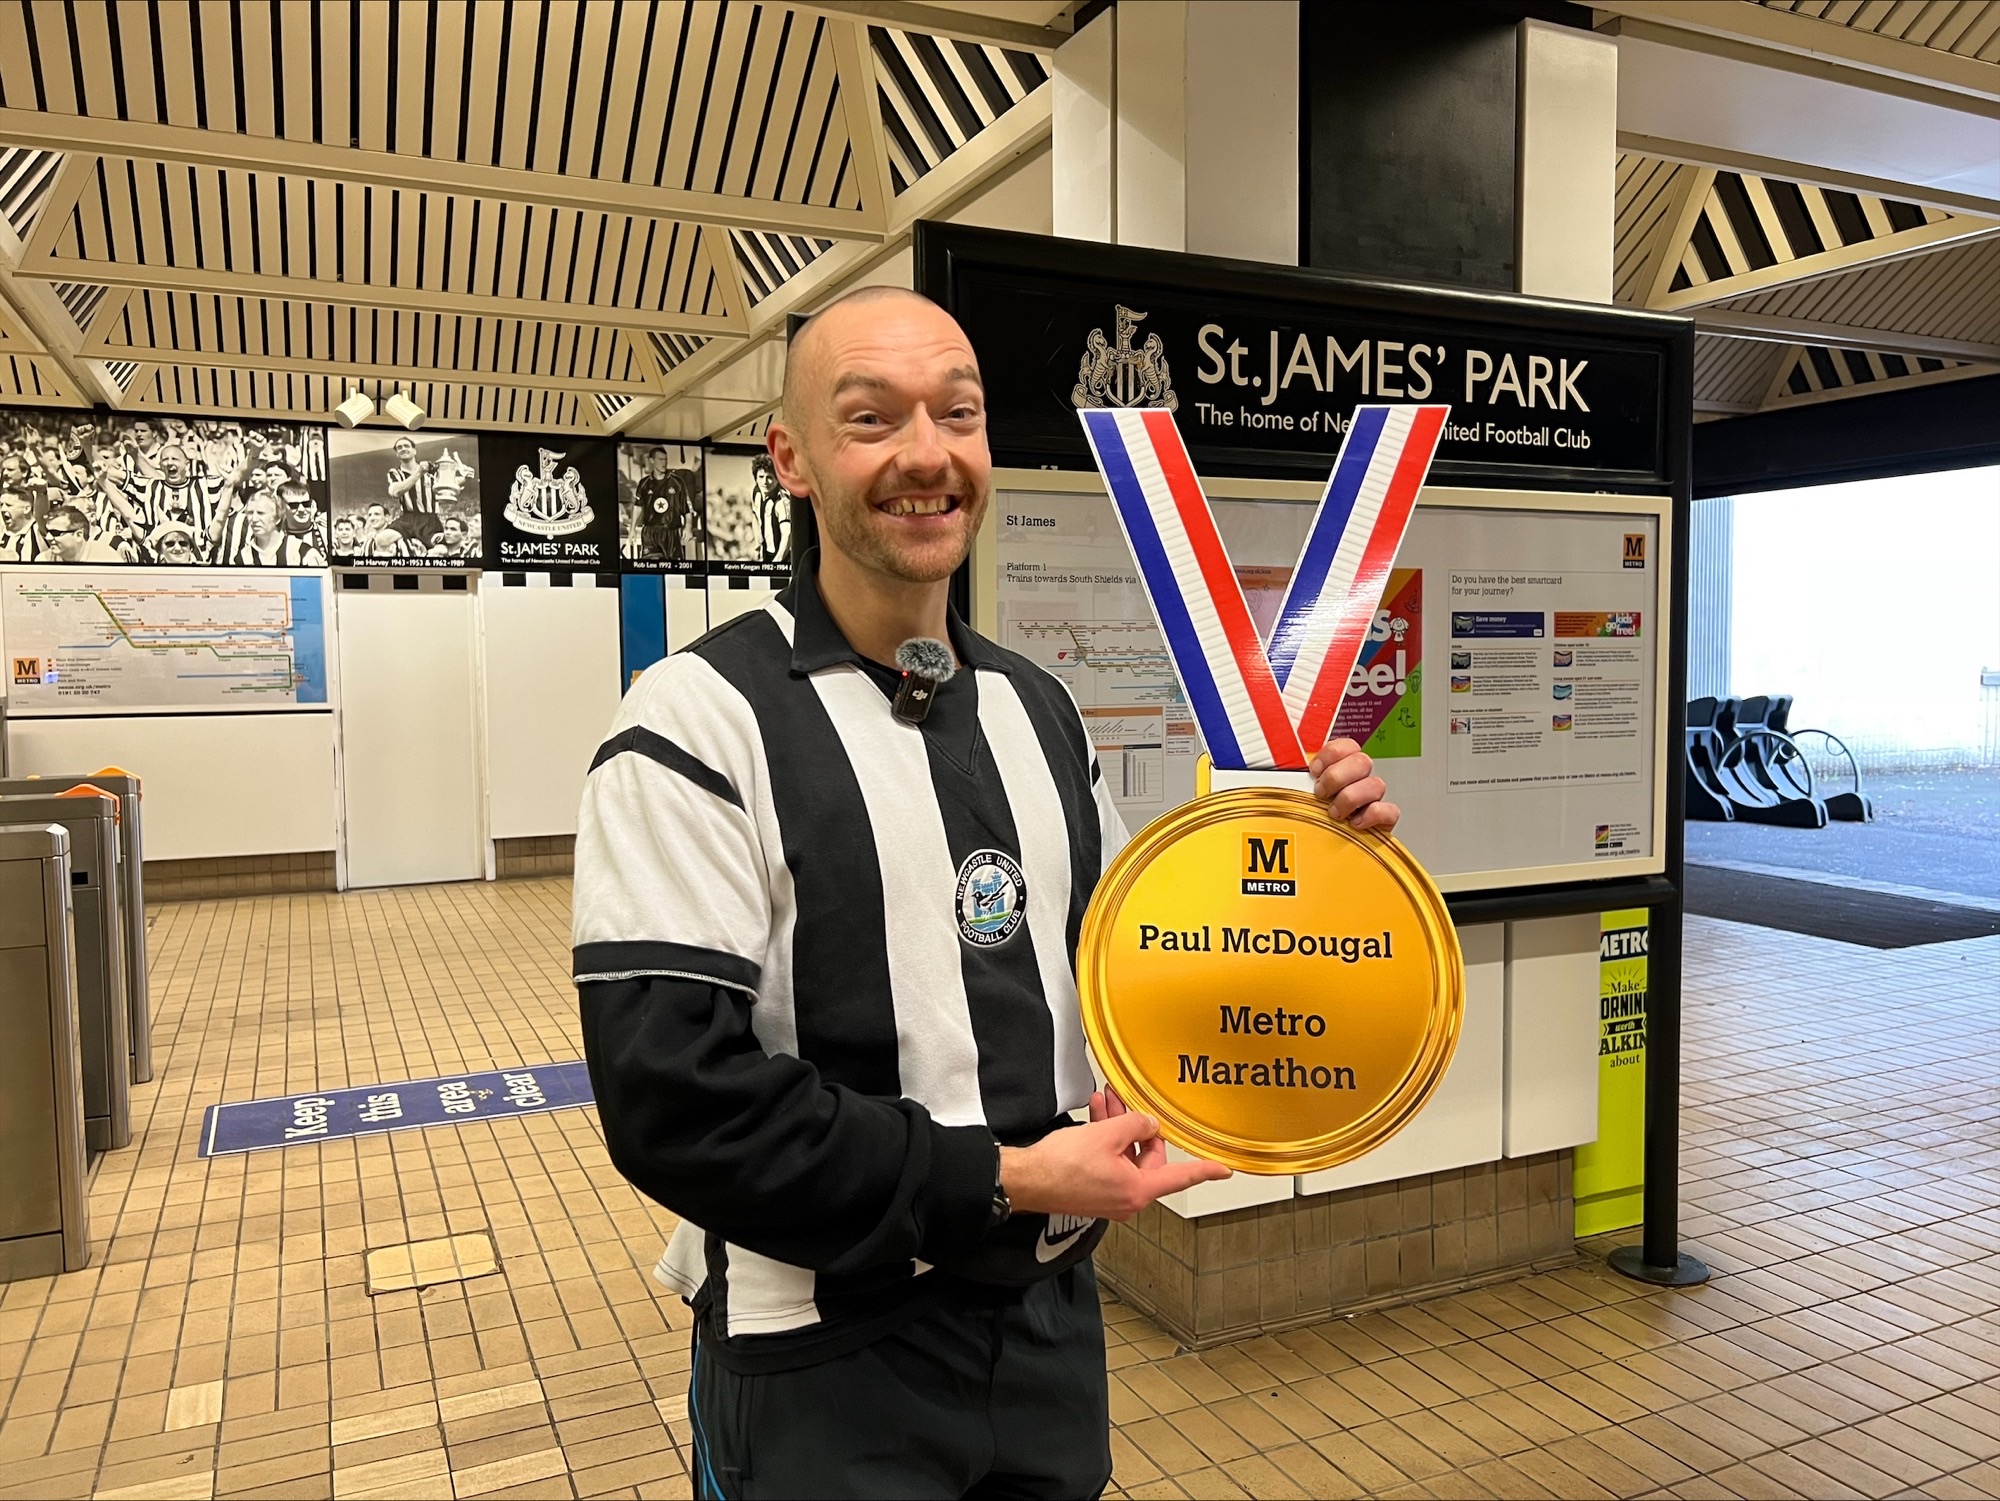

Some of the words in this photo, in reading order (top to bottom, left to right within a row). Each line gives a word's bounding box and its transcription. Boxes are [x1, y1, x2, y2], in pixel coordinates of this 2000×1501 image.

[1466, 349, 1591, 413] PARK
[1195, 402, 1234, 426] The
[1240, 406, 1294, 431] home
[1300, 411, 1320, 432] of
[1442, 422, 1480, 442] nited
[1485, 423, 1549, 447] Football
[1554, 428, 1591, 449] Club
[518, 520, 556, 532] NEWCASTLE
[557, 521, 583, 532] UNITED
[1006, 515, 1018, 526] St
[1021, 515, 1056, 527] James
[565, 543, 599, 556] PARK
[353, 558, 365, 568] Joe
[366, 559, 389, 568] Harvey
[1006, 562, 1041, 571] Platform
[1006, 574, 1033, 583] Trains
[1034, 575, 1067, 583] towards
[1069, 575, 1093, 583] South
[1094, 575, 1123, 584] Shields
[1125, 576, 1137, 584] via
[1451, 575, 1462, 584] Do
[1463, 576, 1477, 585] you
[1478, 575, 1496, 584] have
[1497, 575, 1509, 584] the
[1511, 575, 1526, 584] best
[1527, 576, 1562, 585] smartcard
[1451, 587, 1462, 595] for
[1464, 588, 1480, 596] your
[1481, 587, 1514, 597] journey?
[1605, 621, 1616, 633] go
[1616, 624, 1636, 636] free!
[1615, 612, 1632, 624] kids
[1346, 650, 1407, 697] ee!
[1247, 837, 1289, 874] M
[956, 854, 993, 900] NEWCASTLE
[996, 856, 1023, 887] UNITED
[1247, 882, 1290, 893] METRO
[960, 920, 1003, 944] FOOTBALL
[1003, 909, 1021, 935] CLUB
[1139, 924, 1211, 952] Paul
[1221, 928, 1393, 964] McDougal
[1610, 980, 1640, 995] Make
[1600, 991, 1647, 1020] ORNIN
[1219, 1005, 1327, 1037] Metro
[1614, 1020, 1635, 1032] worth
[1599, 1032, 1646, 1056] ALKIN
[1177, 1054, 1357, 1090] Marathon
[1610, 1054, 1640, 1068] about
[437, 1081, 477, 1114] area
[502, 1073, 547, 1107] clear
[285, 1097, 336, 1139] Keep
[357, 1092, 403, 1123] this
